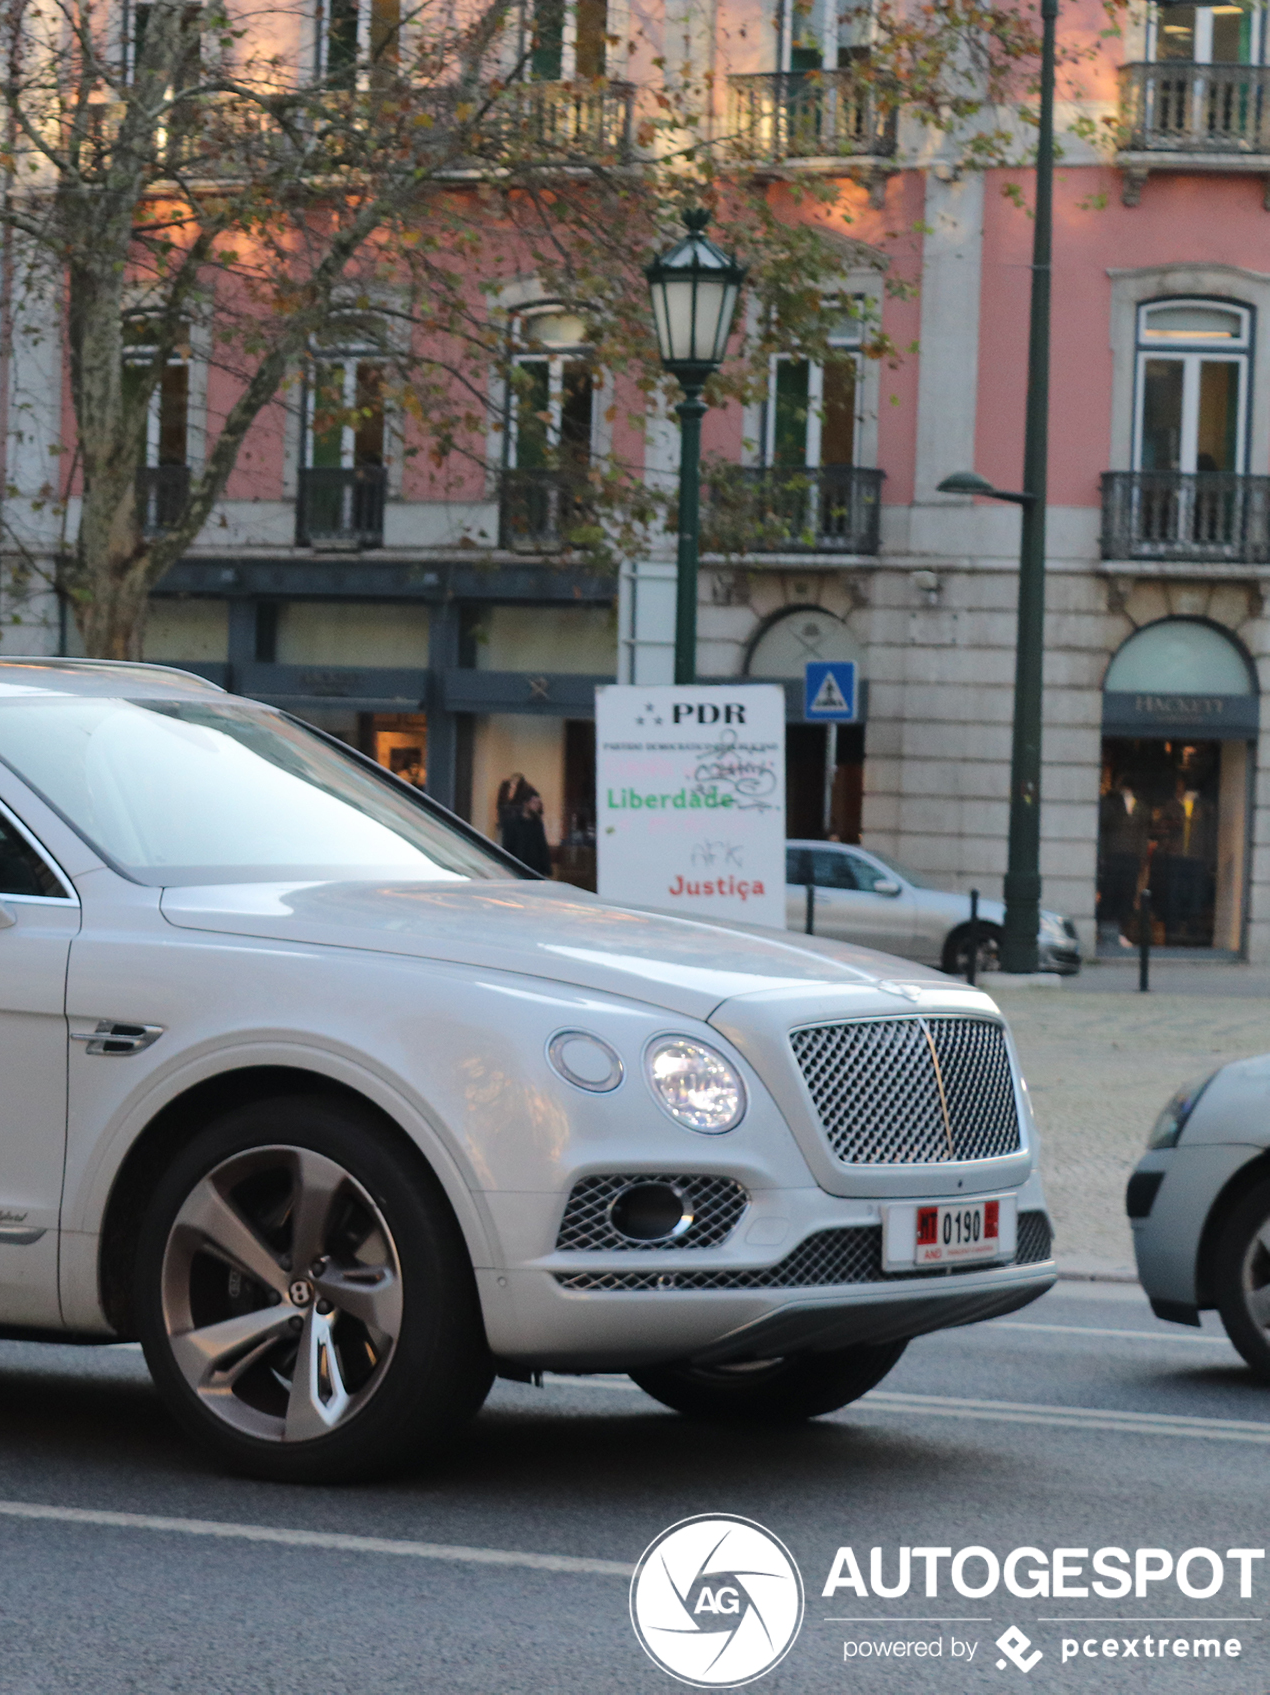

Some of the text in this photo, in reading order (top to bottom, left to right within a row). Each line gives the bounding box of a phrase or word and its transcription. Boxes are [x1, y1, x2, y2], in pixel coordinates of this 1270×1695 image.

[673, 703, 746, 724] PDR
[607, 785, 734, 809] Liberdade
[668, 875, 765, 901] Justiça
[943, 1209, 981, 1245] 0190
